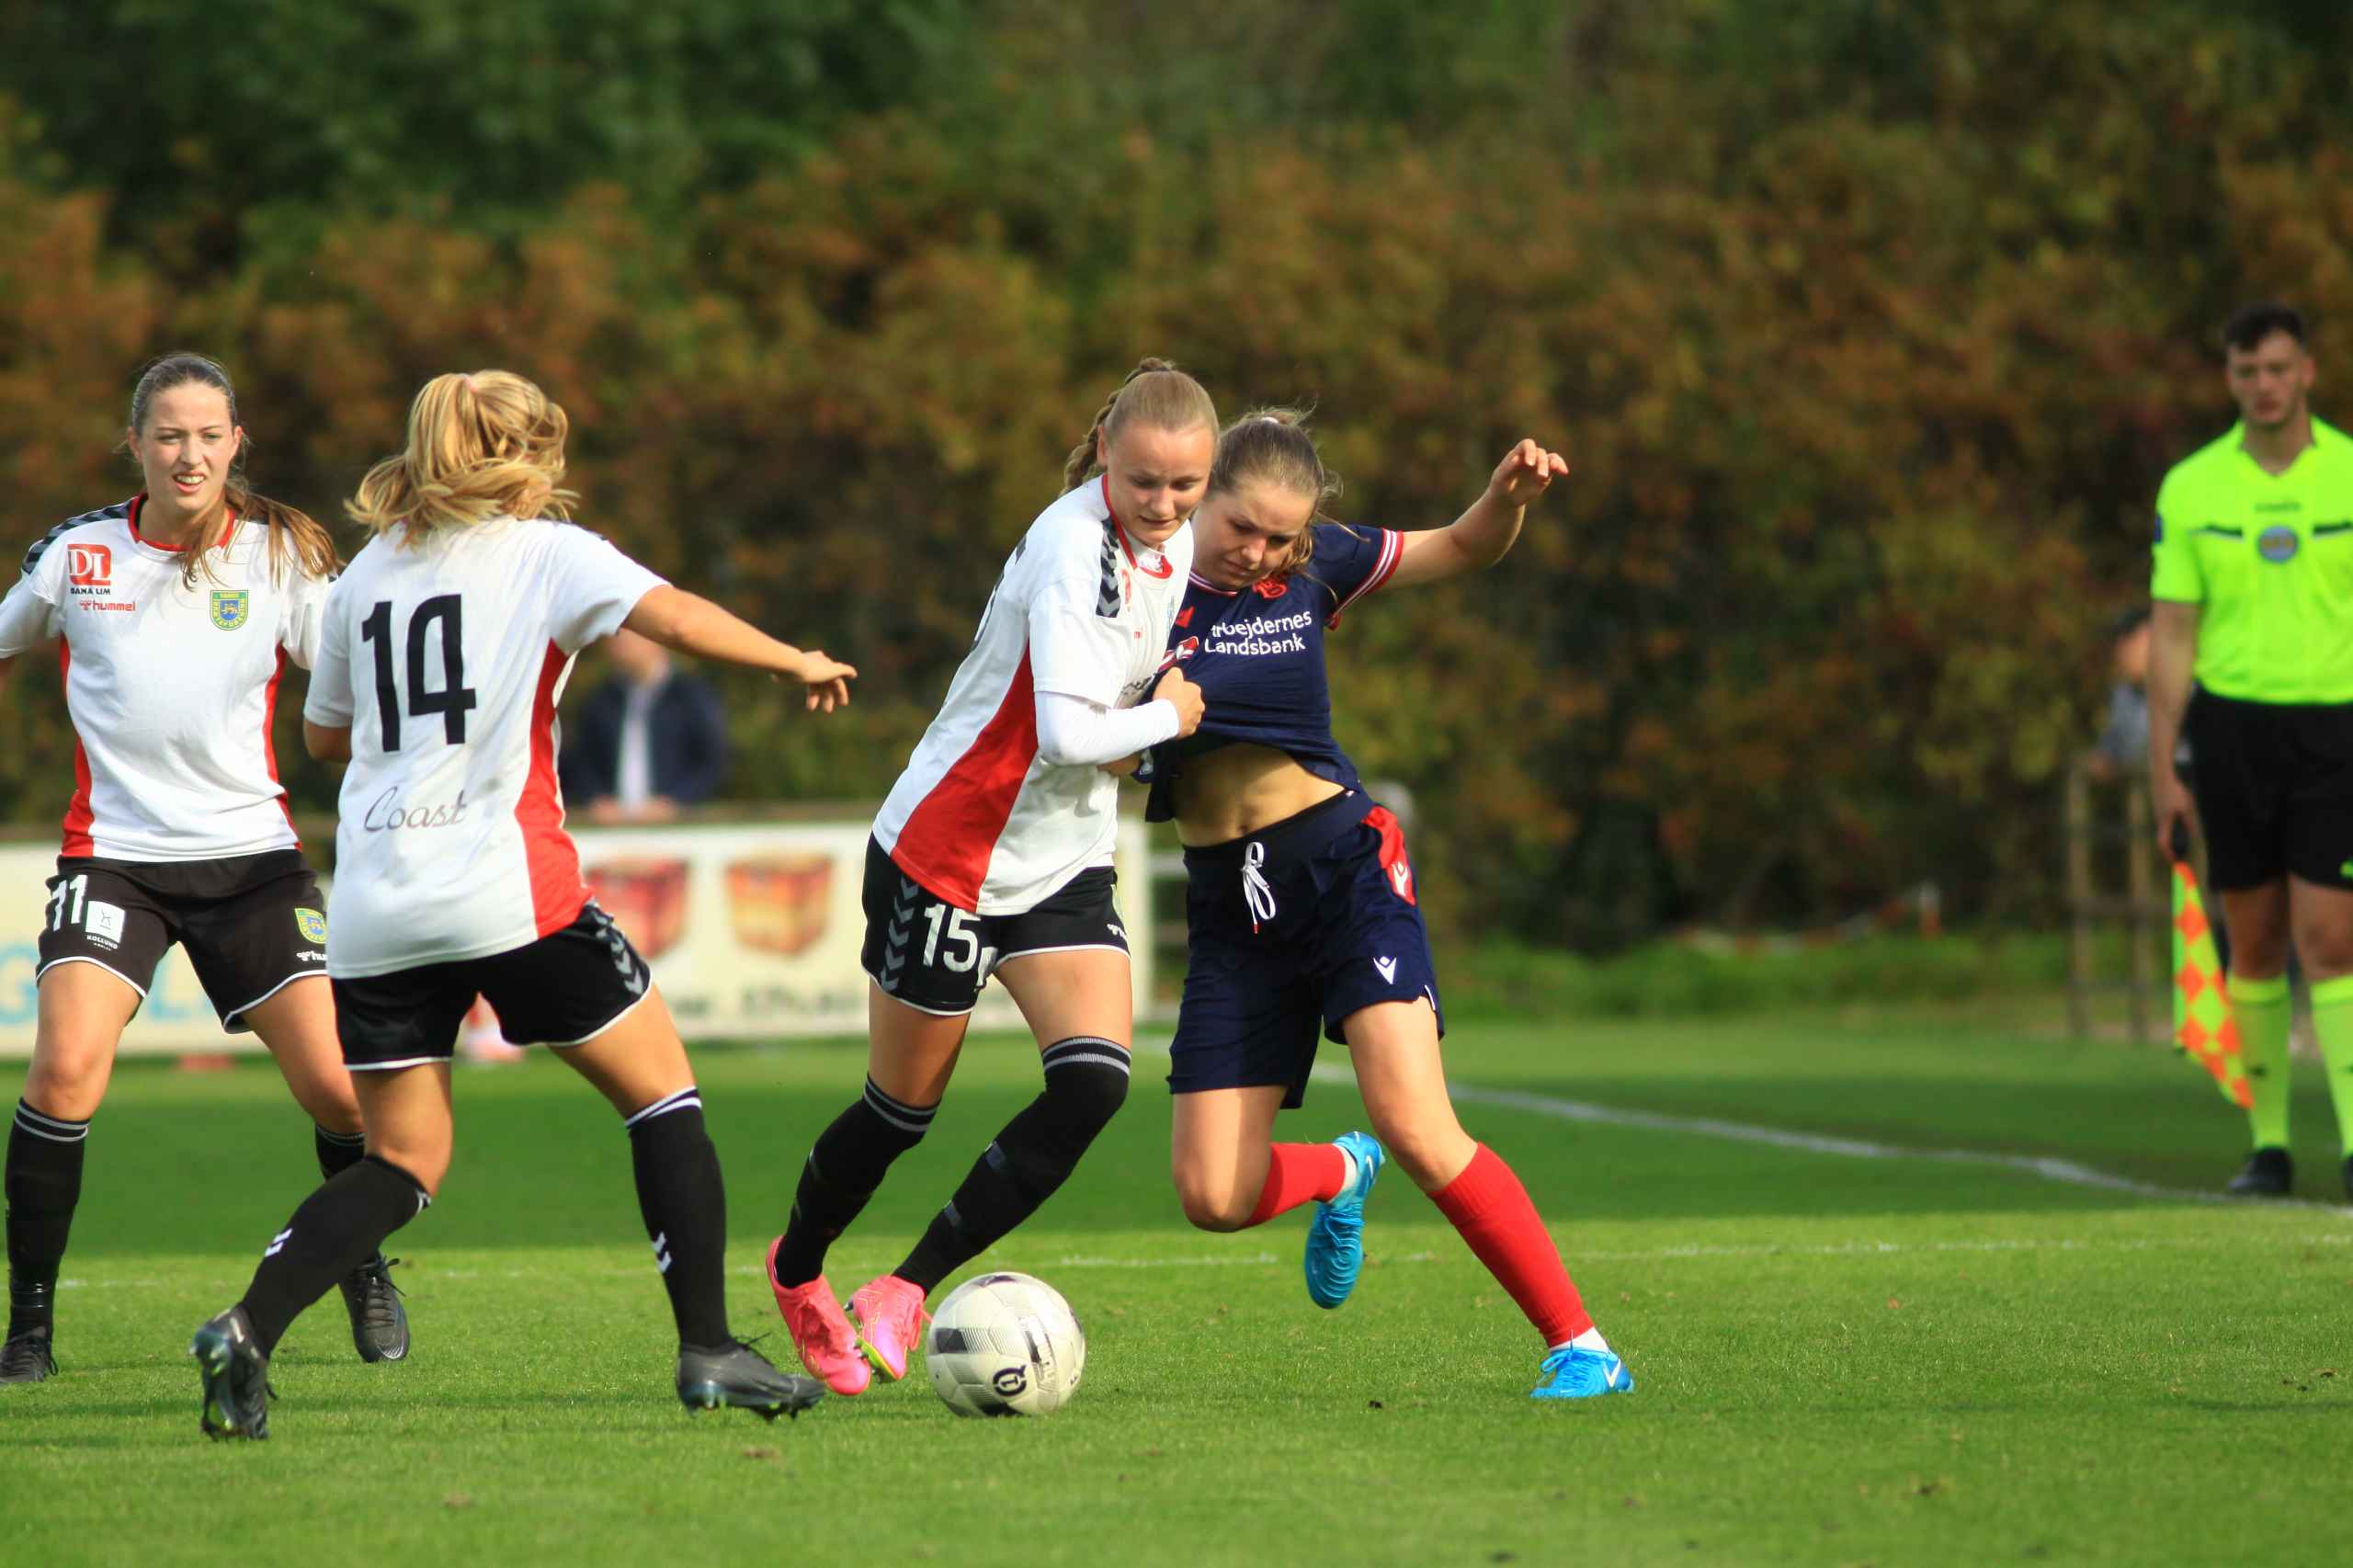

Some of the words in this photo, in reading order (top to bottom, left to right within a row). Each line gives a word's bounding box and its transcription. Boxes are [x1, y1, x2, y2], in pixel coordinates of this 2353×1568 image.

[92, 599, 136, 611] hummel
[1204, 632, 1306, 655] Landsbank
[361, 594, 477, 753] 14
[363, 786, 467, 833] Coast
[51, 874, 88, 932] 11
[923, 903, 982, 973] 15
